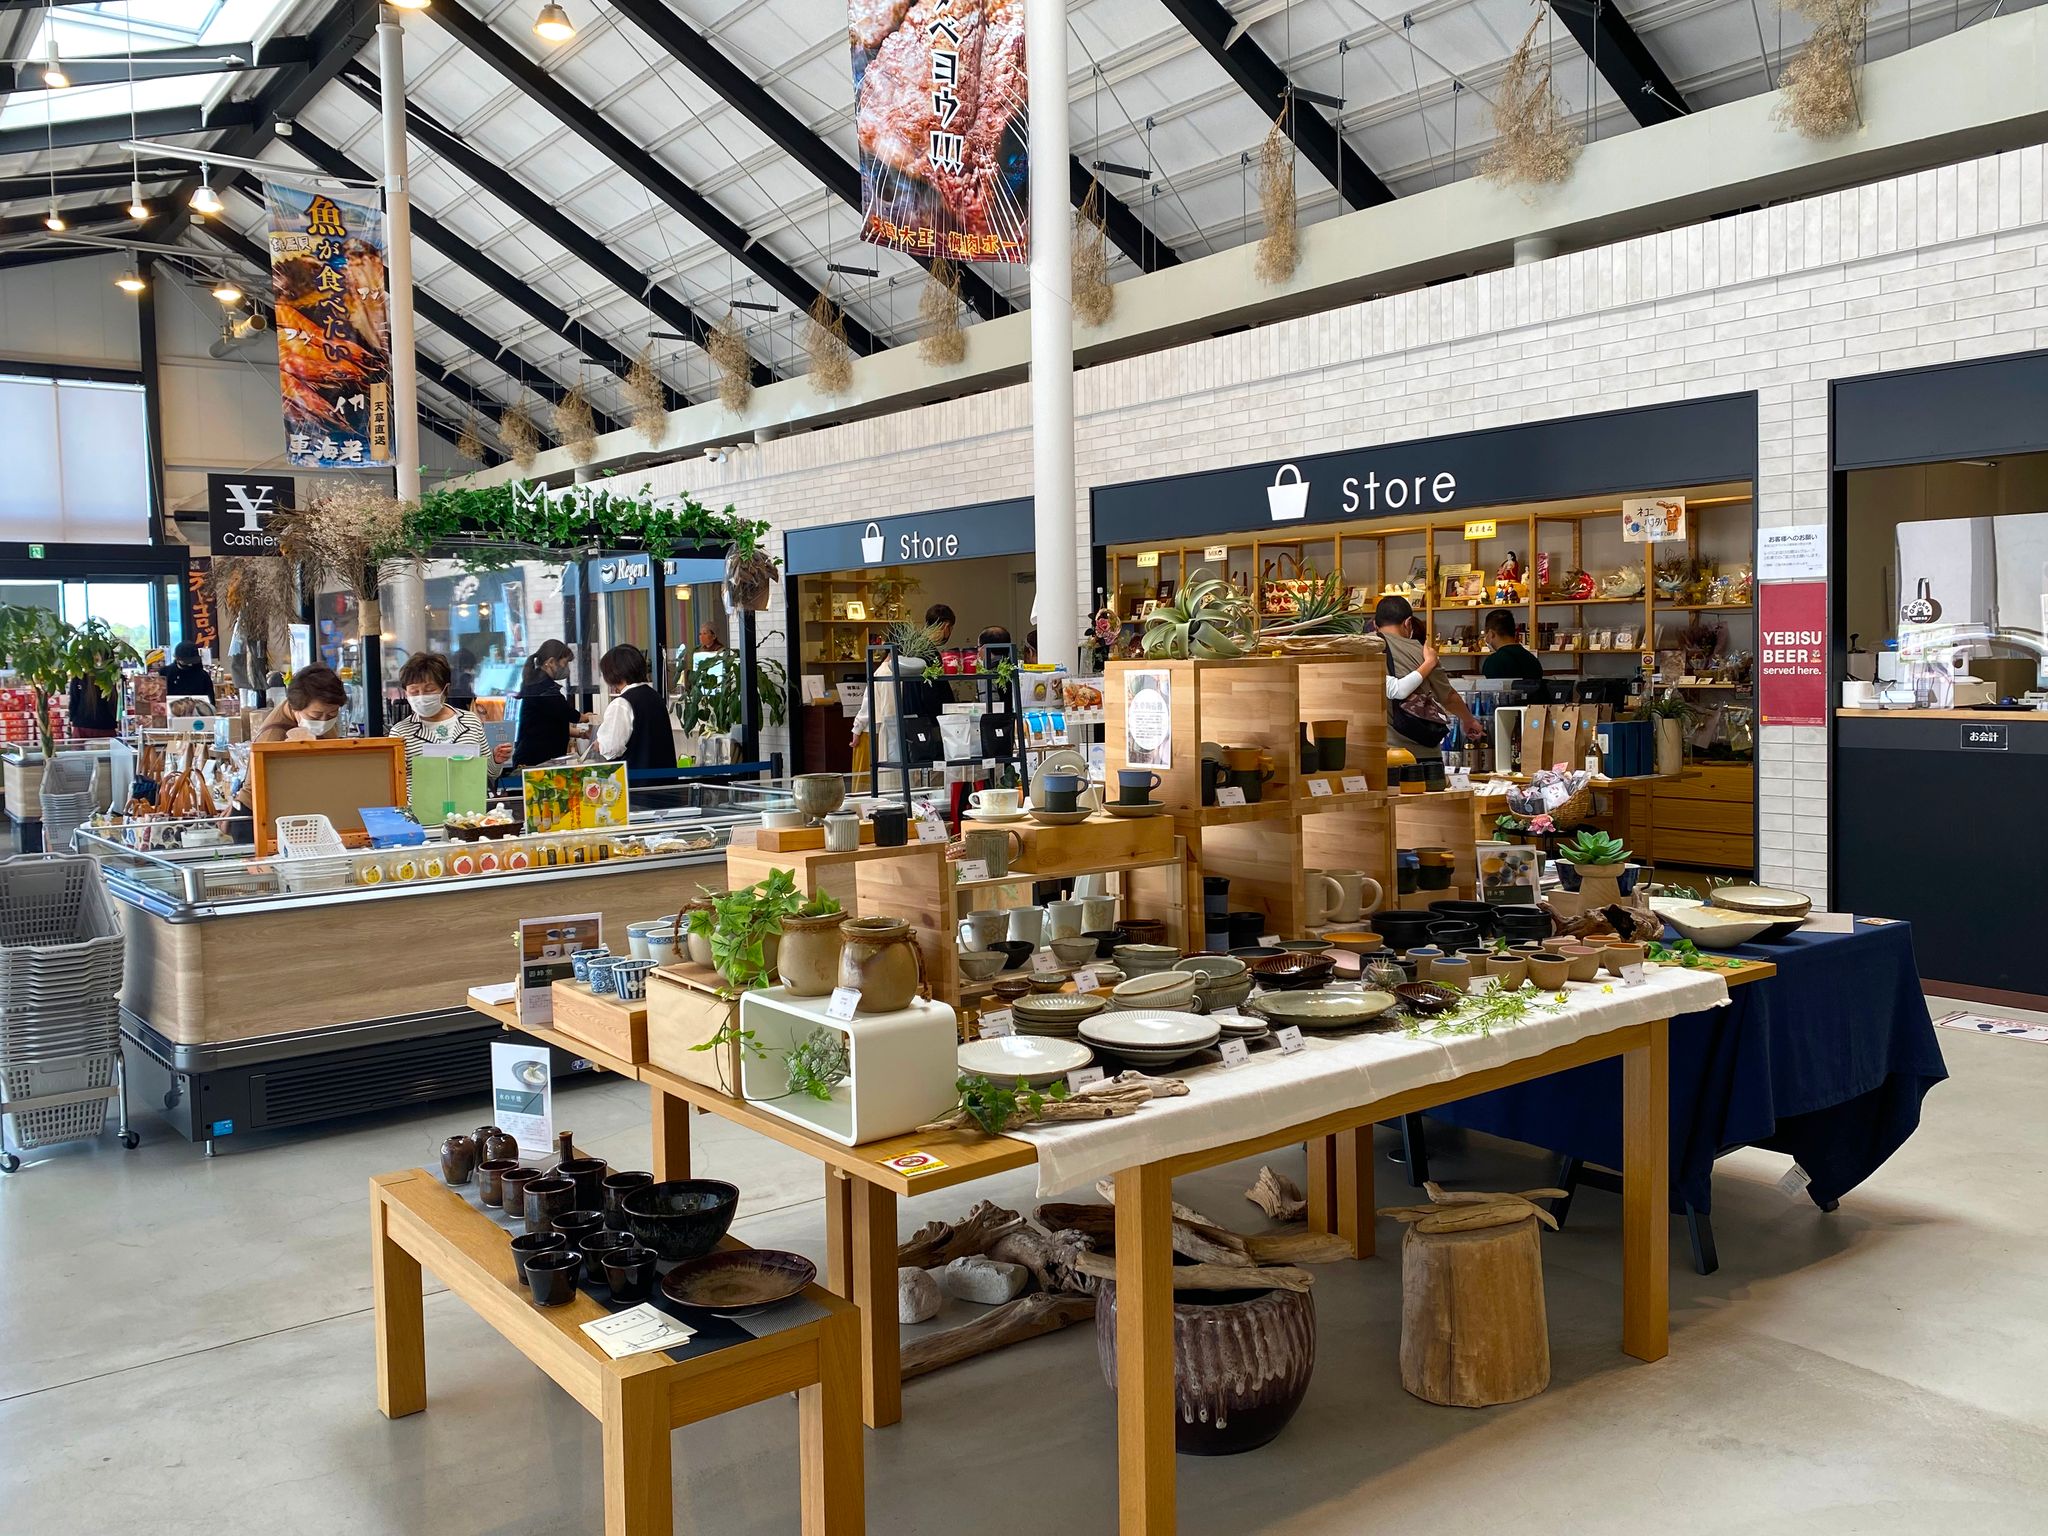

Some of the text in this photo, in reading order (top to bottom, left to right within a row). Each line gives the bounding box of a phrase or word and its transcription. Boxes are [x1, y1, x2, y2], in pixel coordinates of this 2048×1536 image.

[927, 0, 964, 175] ベヨウ!!!
[305, 195, 351, 361] 魚が食べたい
[332, 394, 365, 415] イカ
[374, 401, 386, 446] 天草直送
[289, 432, 364, 462] 車海老
[223, 532, 278, 546] Cashier
[1768, 534, 1818, 543] お客様へのお願い
[1763, 631, 1822, 645] YEBISU
[1763, 649, 1808, 663] BEER
[1763, 666, 1822, 675] served here.
[1969, 731, 1999, 743] お会計
